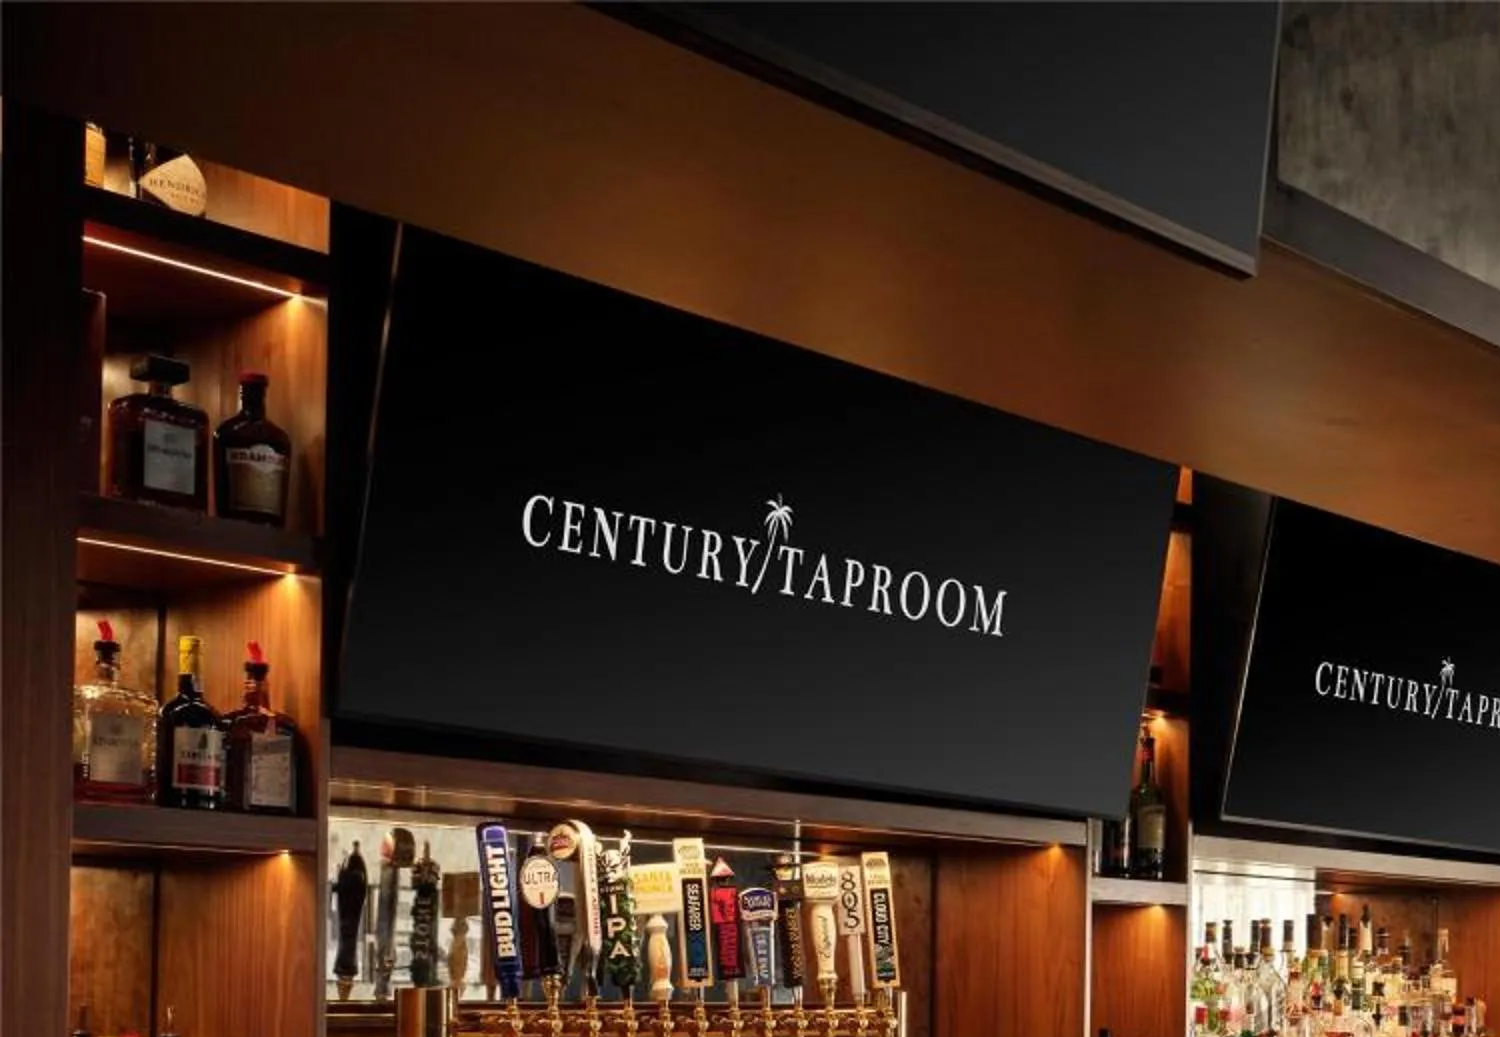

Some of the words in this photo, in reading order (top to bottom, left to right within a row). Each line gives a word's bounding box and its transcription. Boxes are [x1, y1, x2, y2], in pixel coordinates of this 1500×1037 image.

[521, 494, 761, 588] CENTURY
[778, 544, 1008, 637] TAPROOM
[1314, 661, 1438, 716] CENTURY
[485, 845, 511, 909] LIGHT
[522, 870, 557, 886] ULTRA
[841, 870, 860, 929] 805
[493, 910, 517, 958] BUD
[606, 893, 631, 959] IPA
[872, 892, 889, 923] CLOUD
